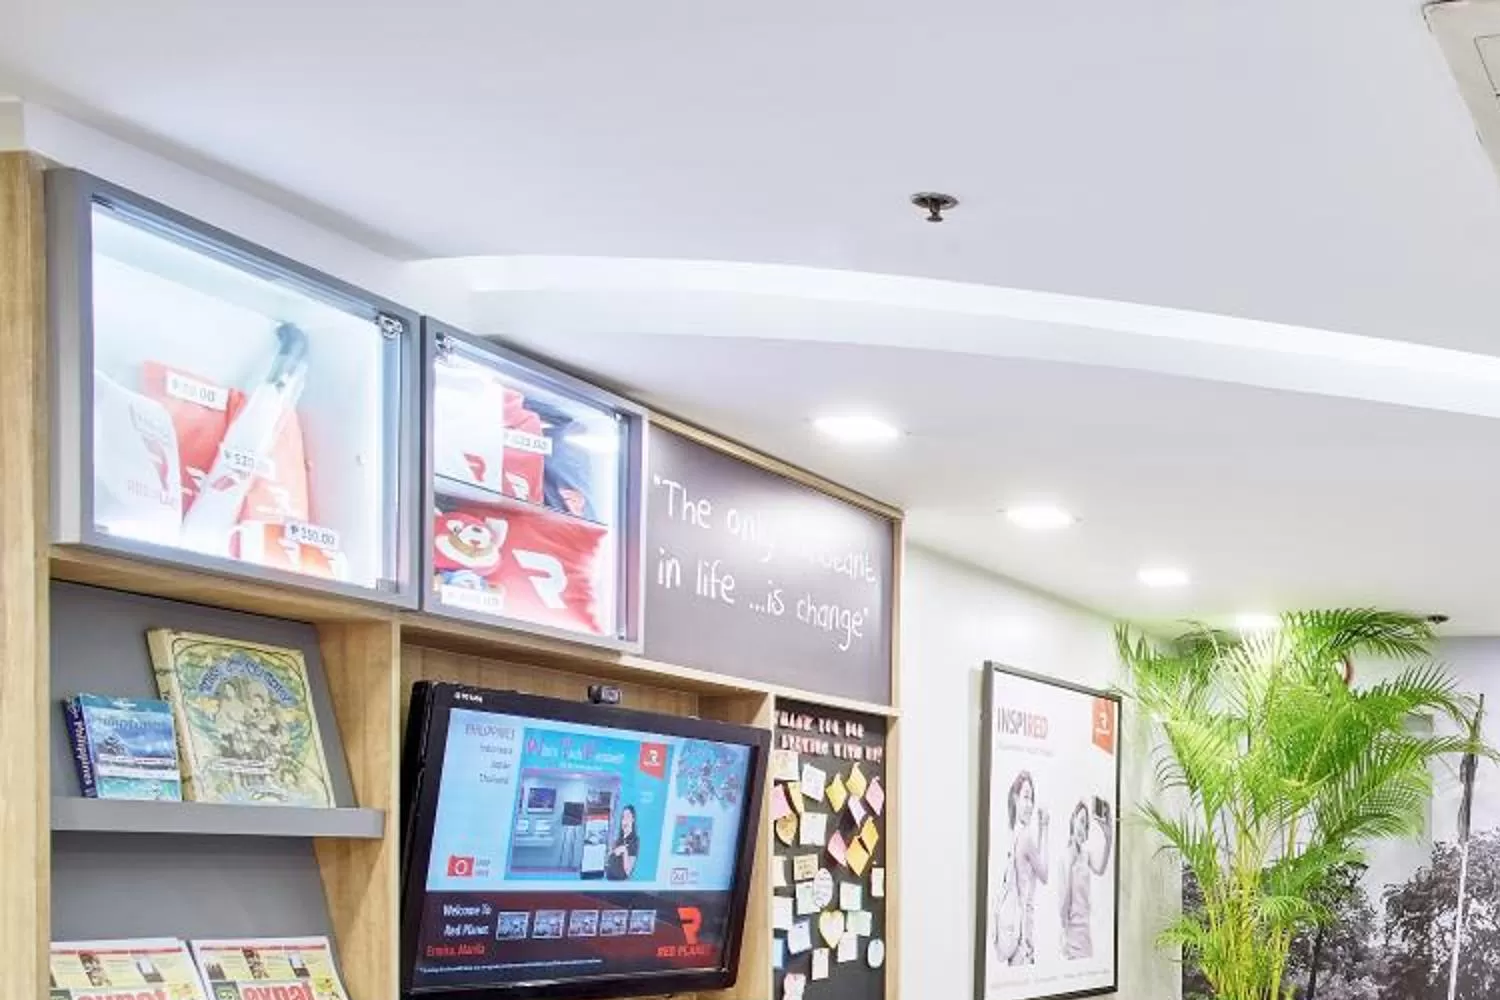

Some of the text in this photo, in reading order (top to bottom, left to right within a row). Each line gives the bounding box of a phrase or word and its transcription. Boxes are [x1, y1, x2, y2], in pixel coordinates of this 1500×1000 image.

[656, 546, 681, 589] in
[695, 559, 736, 605] life
[997, 707, 1049, 741] INSPIRED
